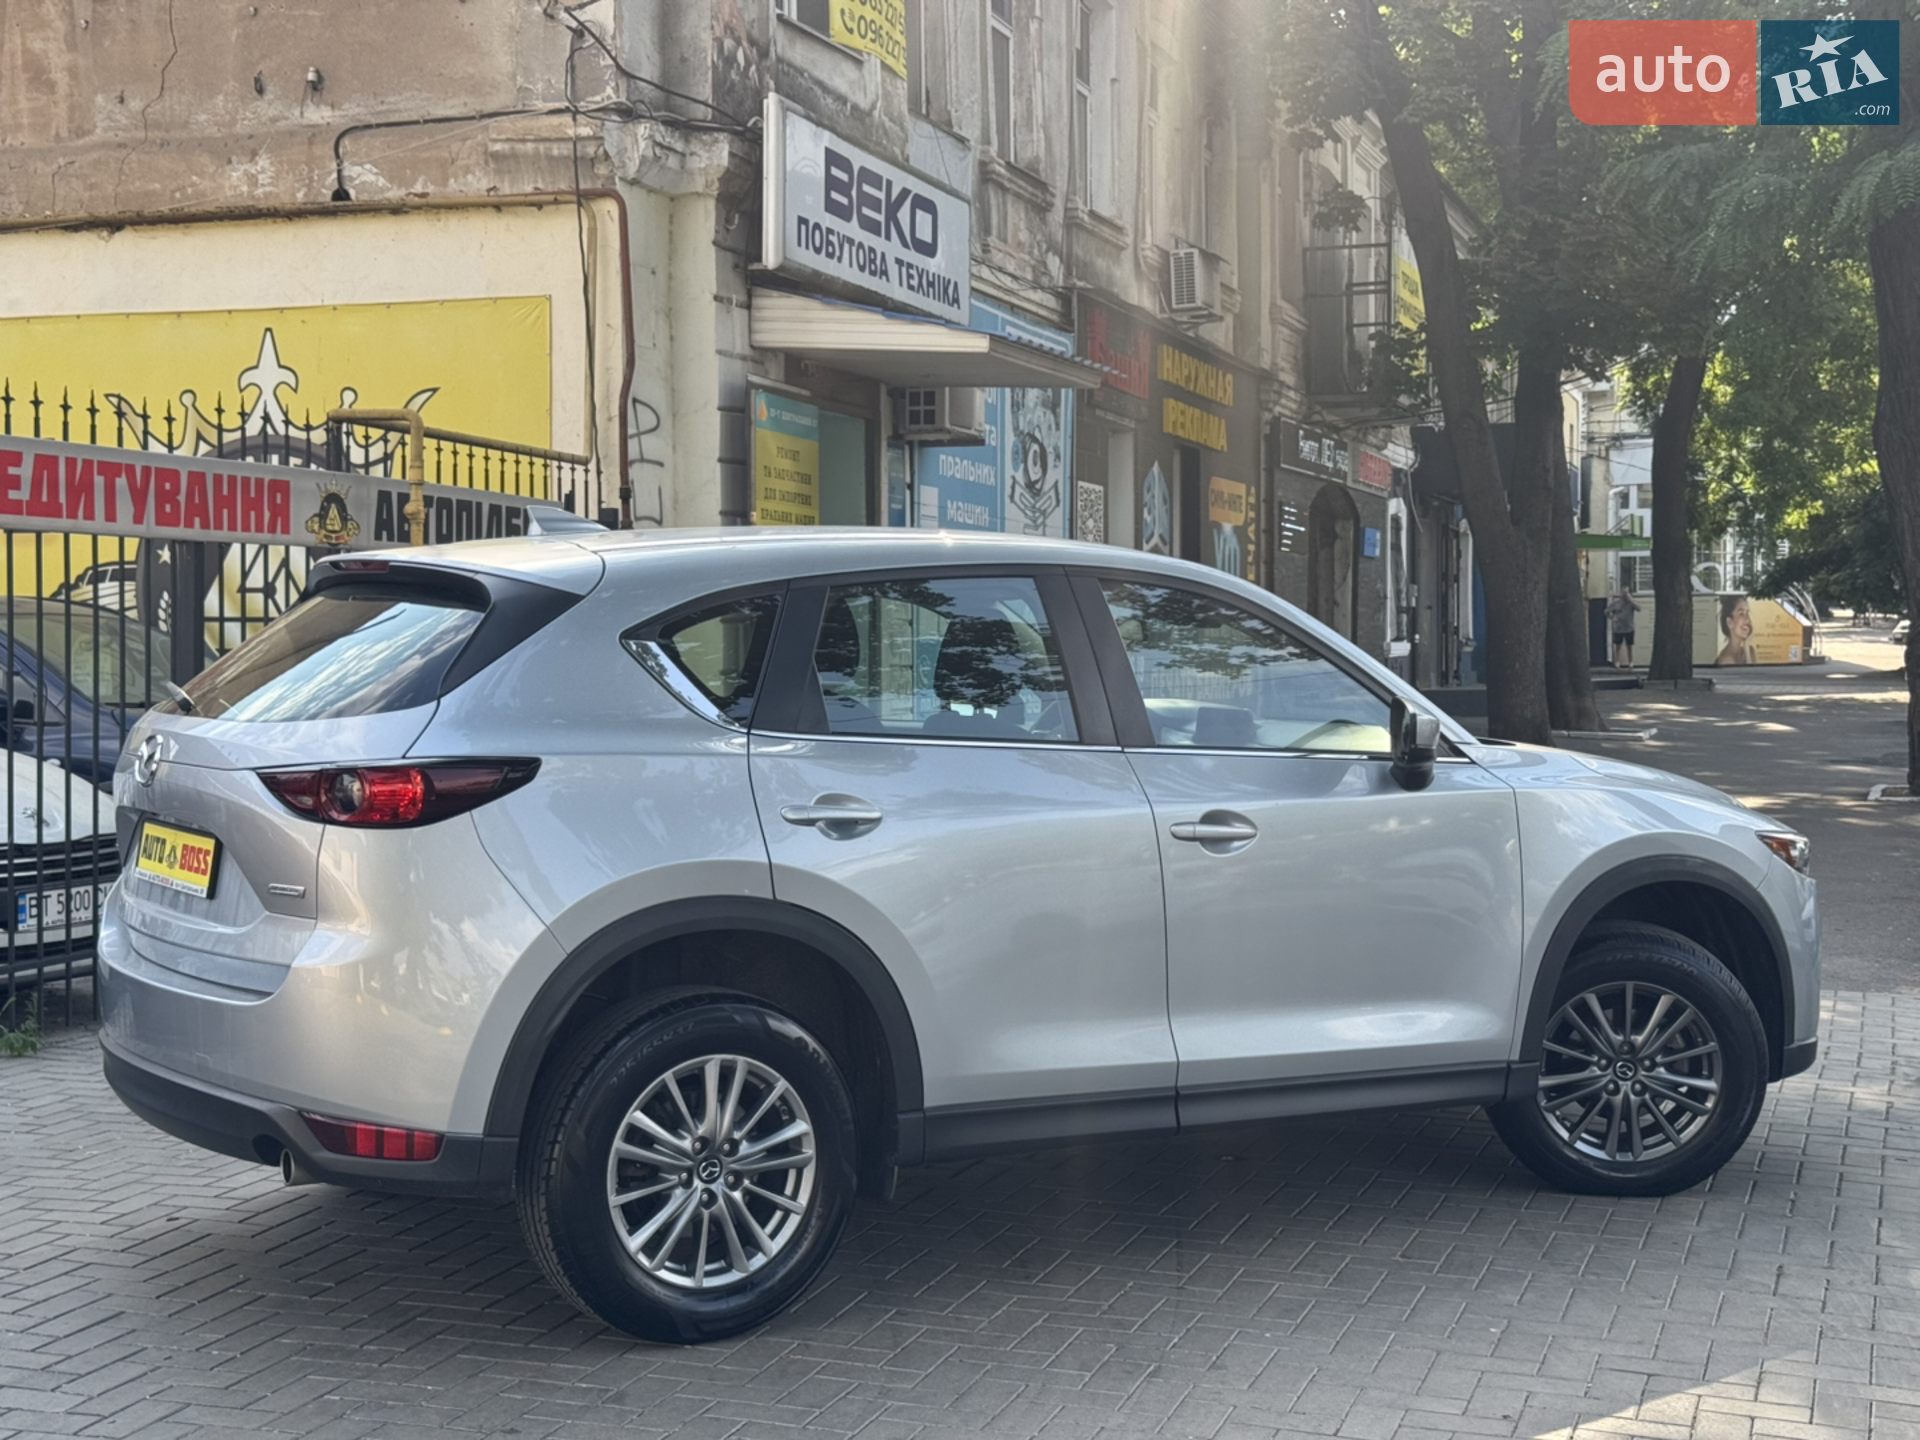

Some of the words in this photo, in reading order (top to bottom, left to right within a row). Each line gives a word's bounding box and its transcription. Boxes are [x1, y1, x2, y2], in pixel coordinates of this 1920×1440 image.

[824, 145, 938, 260] BEKO
[797, 214, 890, 284] ПОБУТОВА
[894, 257, 961, 311] ТЕХНІКА
[1157, 343, 1234, 407] НАРУЖНАЯ
[1163, 396, 1228, 452] РЕКЛАМА
[0, 450, 291, 535] ЕДИТУВАННЯ
[938, 453, 996, 487] пральних
[946, 499, 989, 527] машин
[141, 833, 168, 864] AUTO
[179, 843, 212, 876] BOSS
